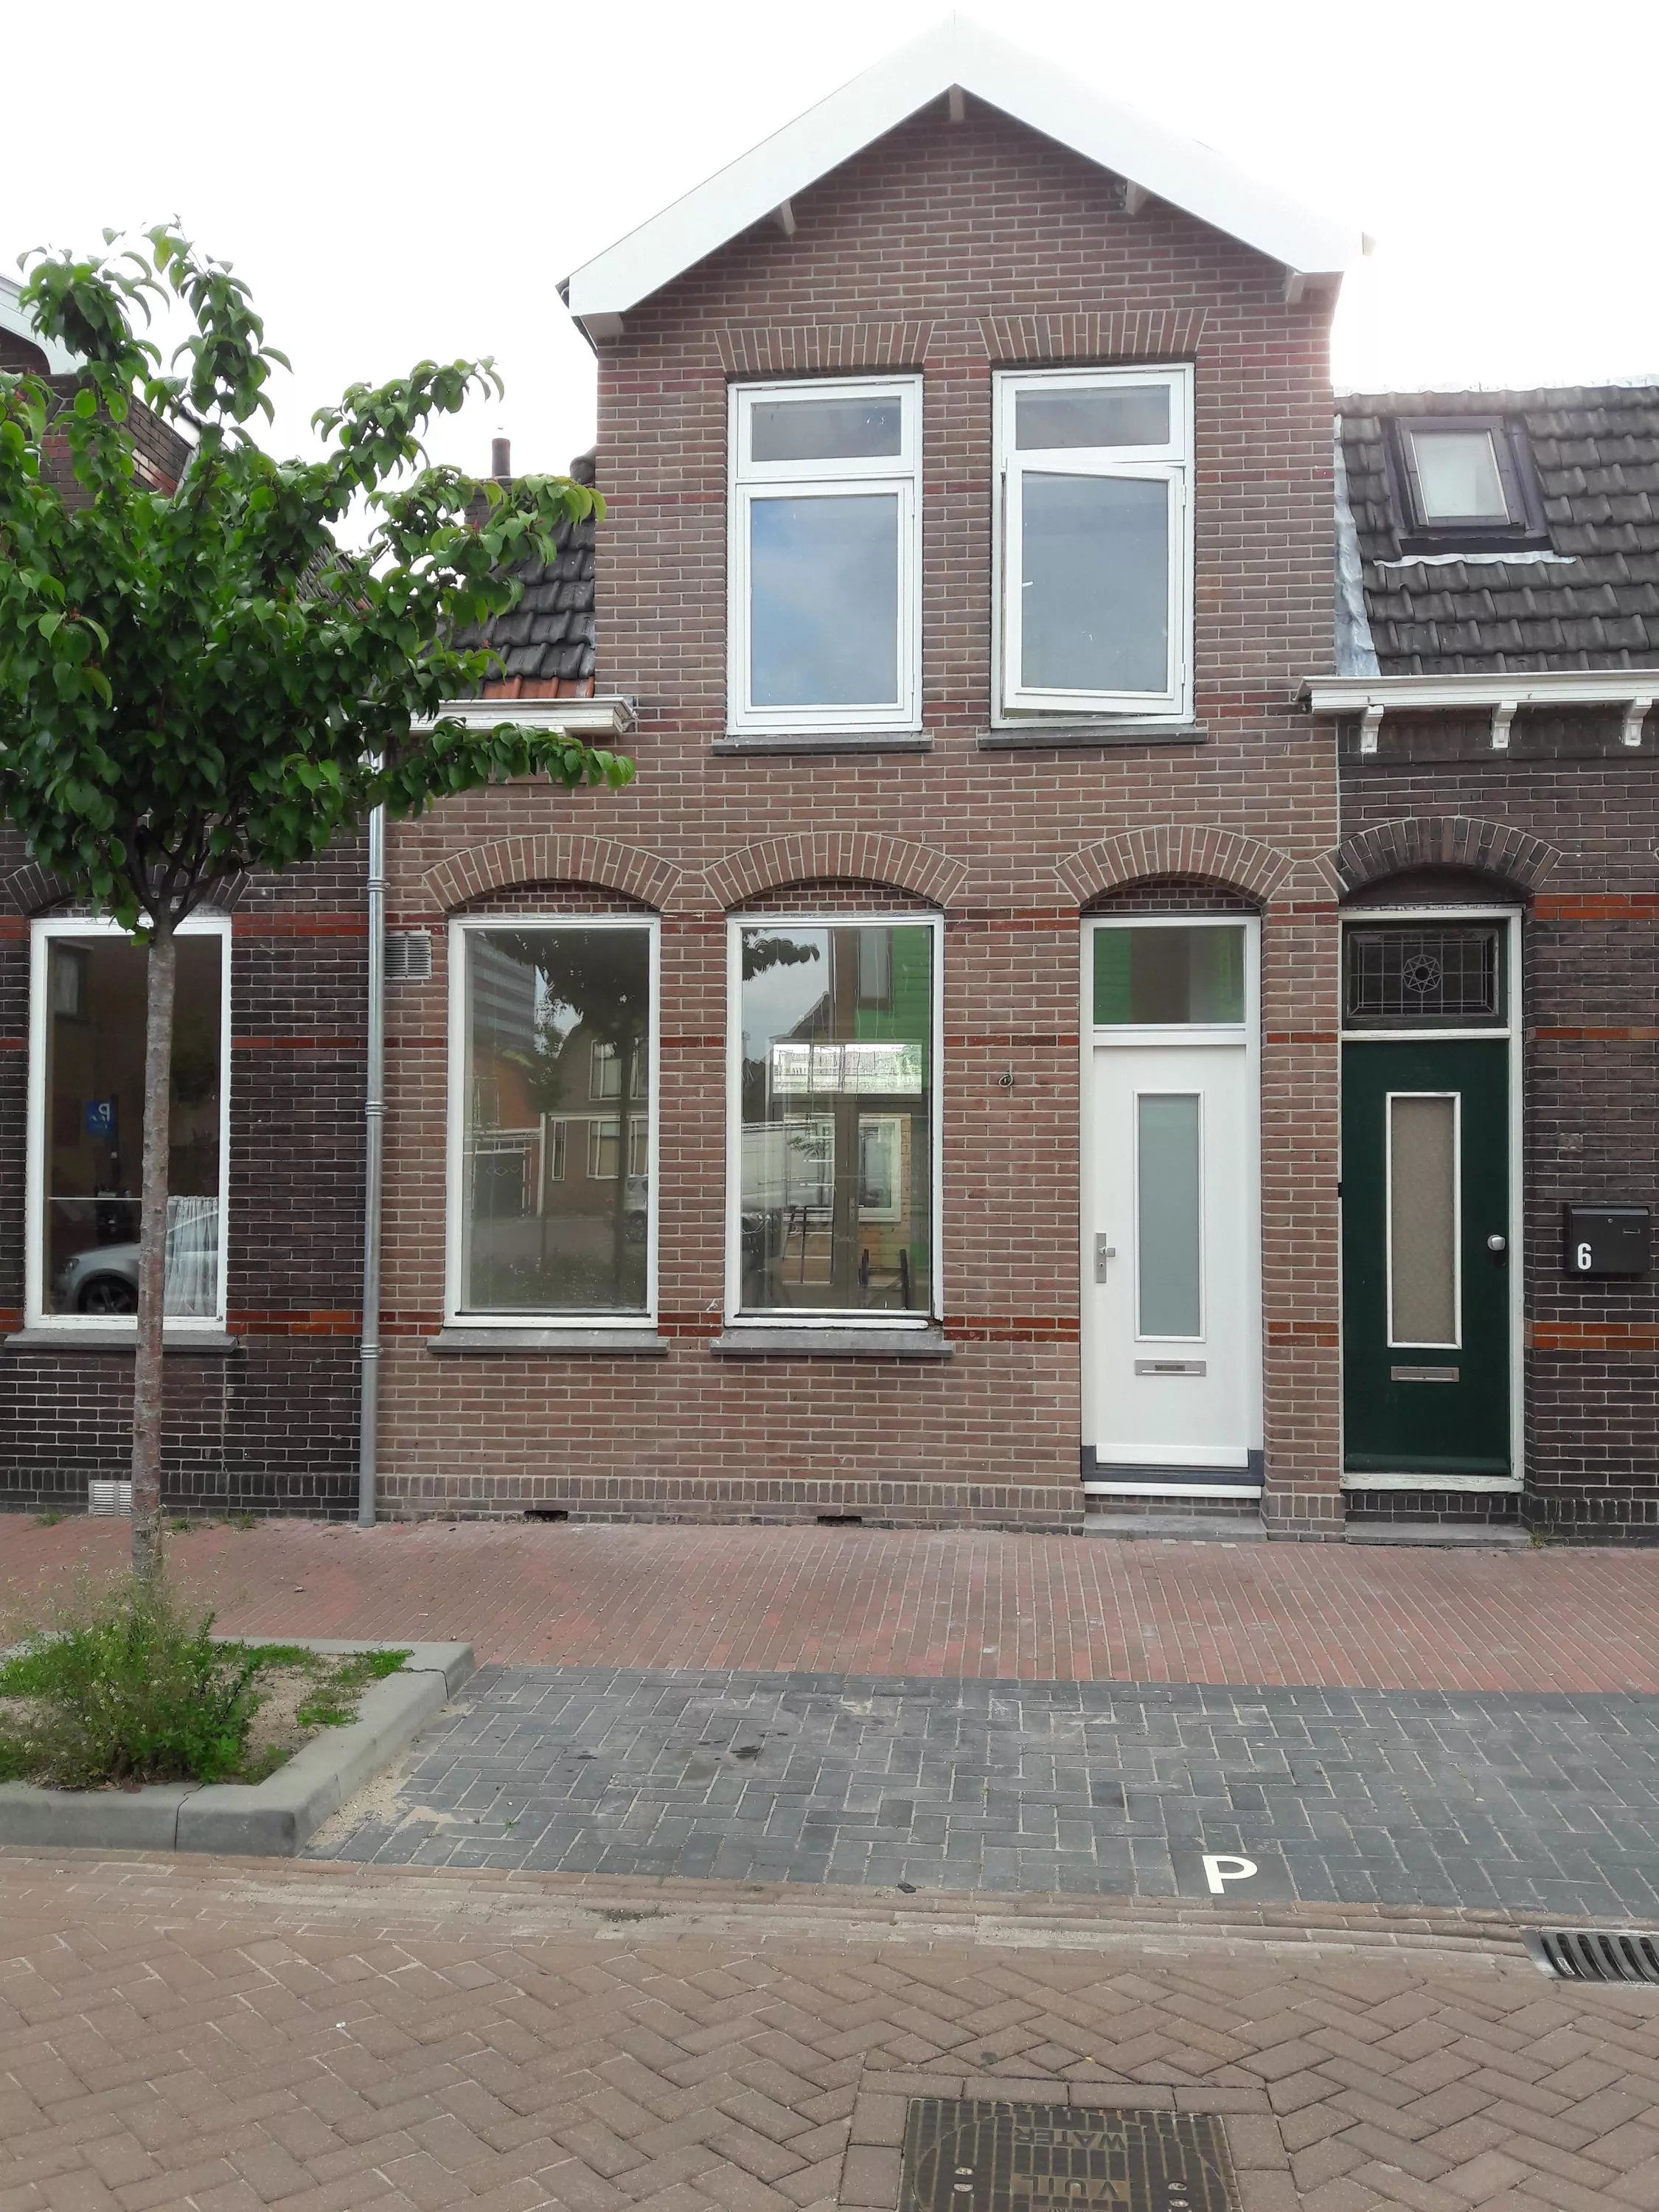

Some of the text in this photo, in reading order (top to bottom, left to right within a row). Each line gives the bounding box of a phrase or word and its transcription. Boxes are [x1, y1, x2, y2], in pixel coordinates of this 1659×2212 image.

[1578, 1242, 1592, 1270] 6
[1202, 1855, 1258, 1894] P
[1015, 2126, 1125, 2151] WATER
[1021, 2175, 1119, 2199] VUIL
